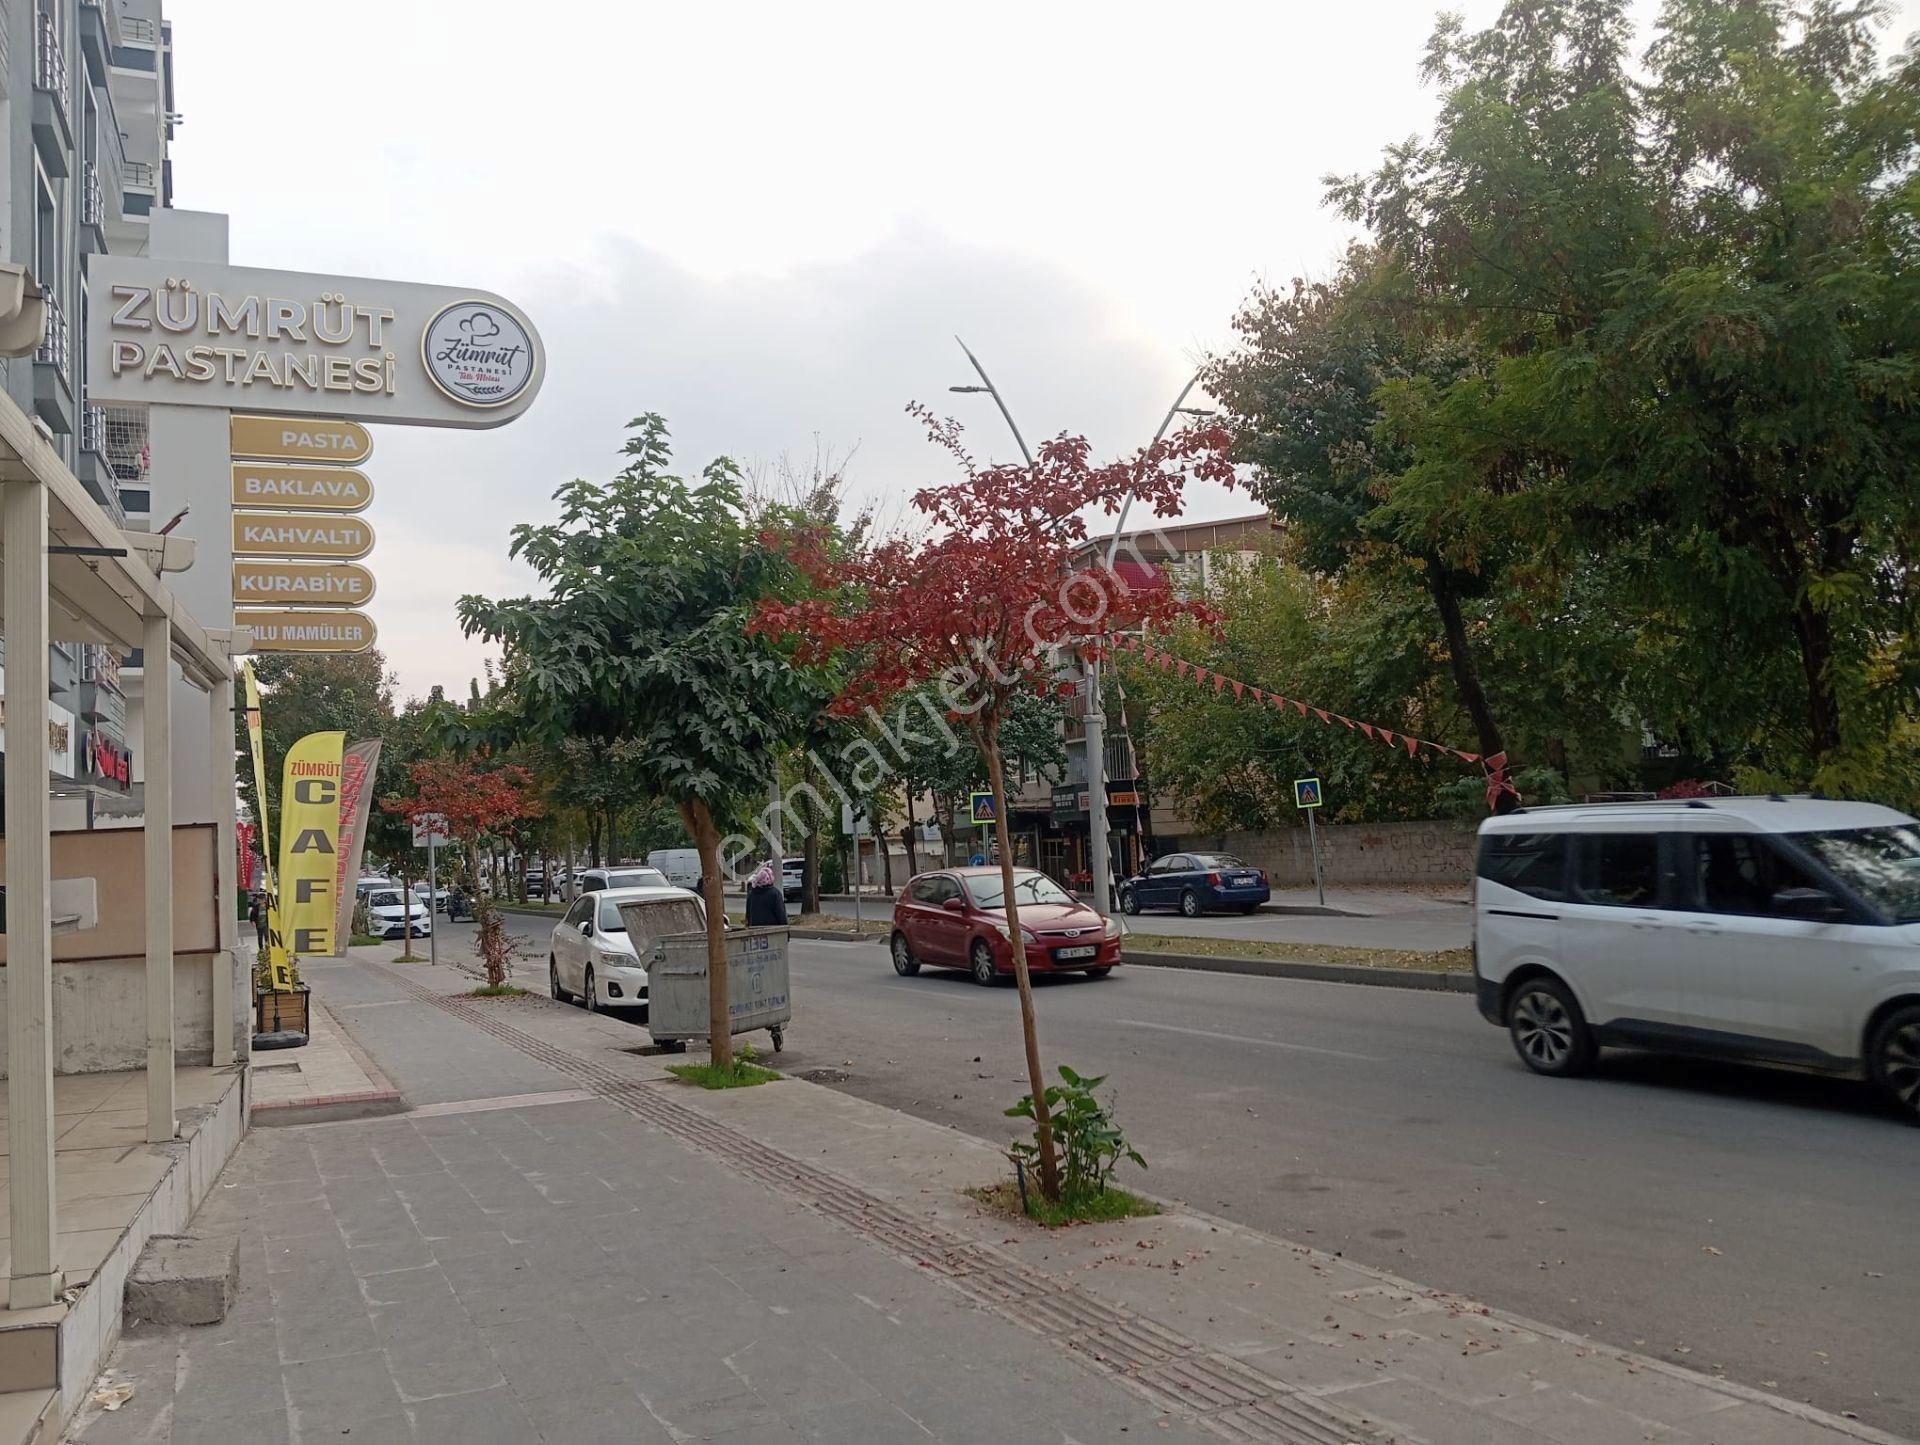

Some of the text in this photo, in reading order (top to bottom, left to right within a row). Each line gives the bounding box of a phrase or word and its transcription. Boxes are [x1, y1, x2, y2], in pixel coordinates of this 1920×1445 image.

[111, 278, 394, 349] ZÜMRÜT
[437, 338, 526, 369] Zümrüt
[112, 339, 396, 395] PASTANESİ
[447, 364, 512, 376] PASTANESİ
[281, 431, 358, 450] PASTA
[245, 477, 359, 498] BAKLAVA
[244, 525, 361, 546] KAHVALTI
[240, 571, 362, 593] KURABİYE
[250, 623, 362, 641] NLU MAMÜLLER
[291, 760, 341, 777] ZÜMRÜT
[338, 754, 367, 827] KASAP
[290, 779, 336, 953] CAFE
